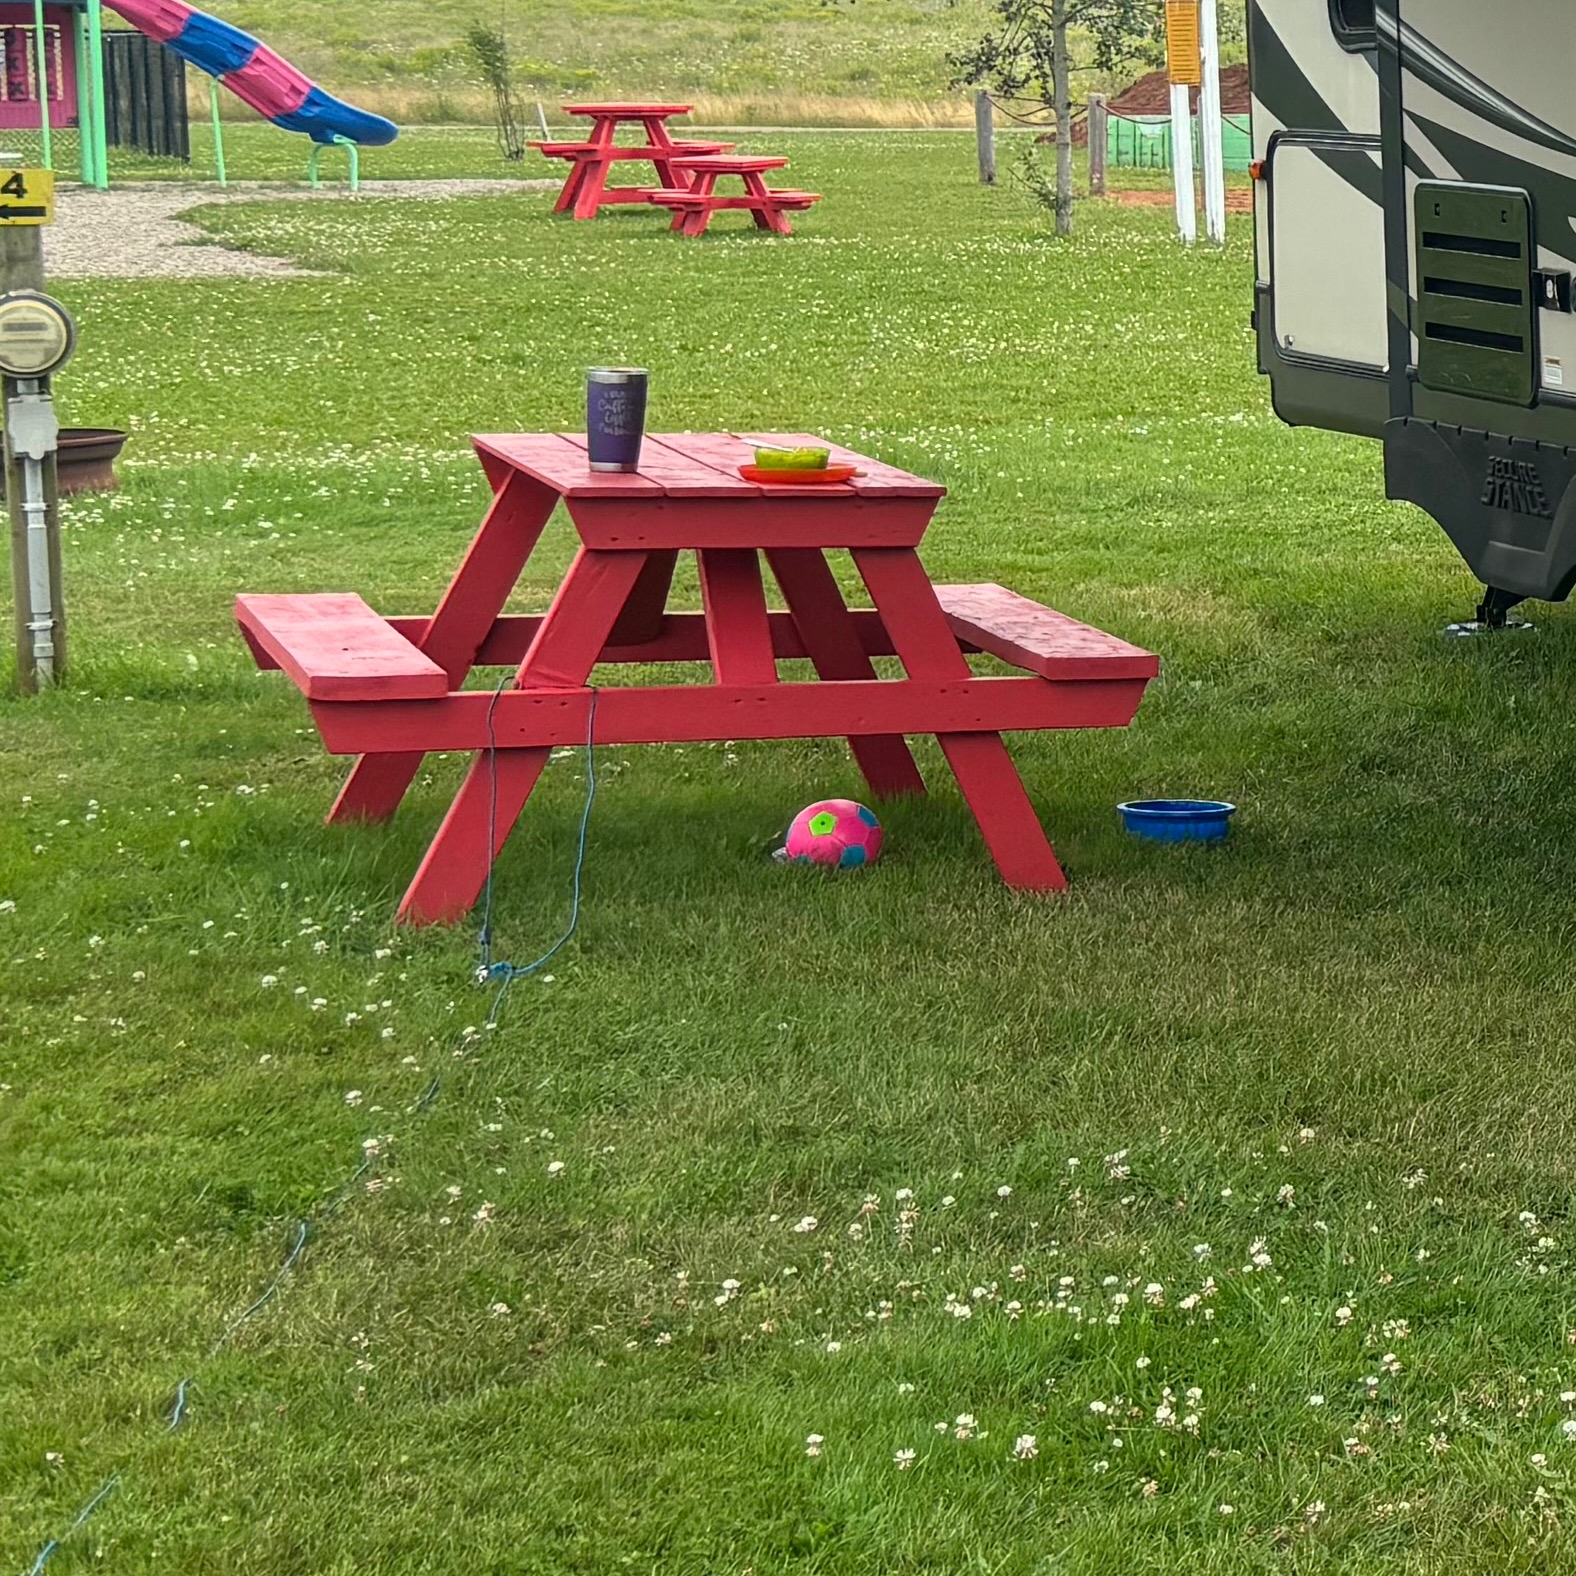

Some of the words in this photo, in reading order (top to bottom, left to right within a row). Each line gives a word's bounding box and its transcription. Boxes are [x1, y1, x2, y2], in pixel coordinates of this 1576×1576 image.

[1, 172, 28, 198] 4
[1486, 455, 1541, 486] SECURE
[1480, 476, 1554, 519] STANCE
